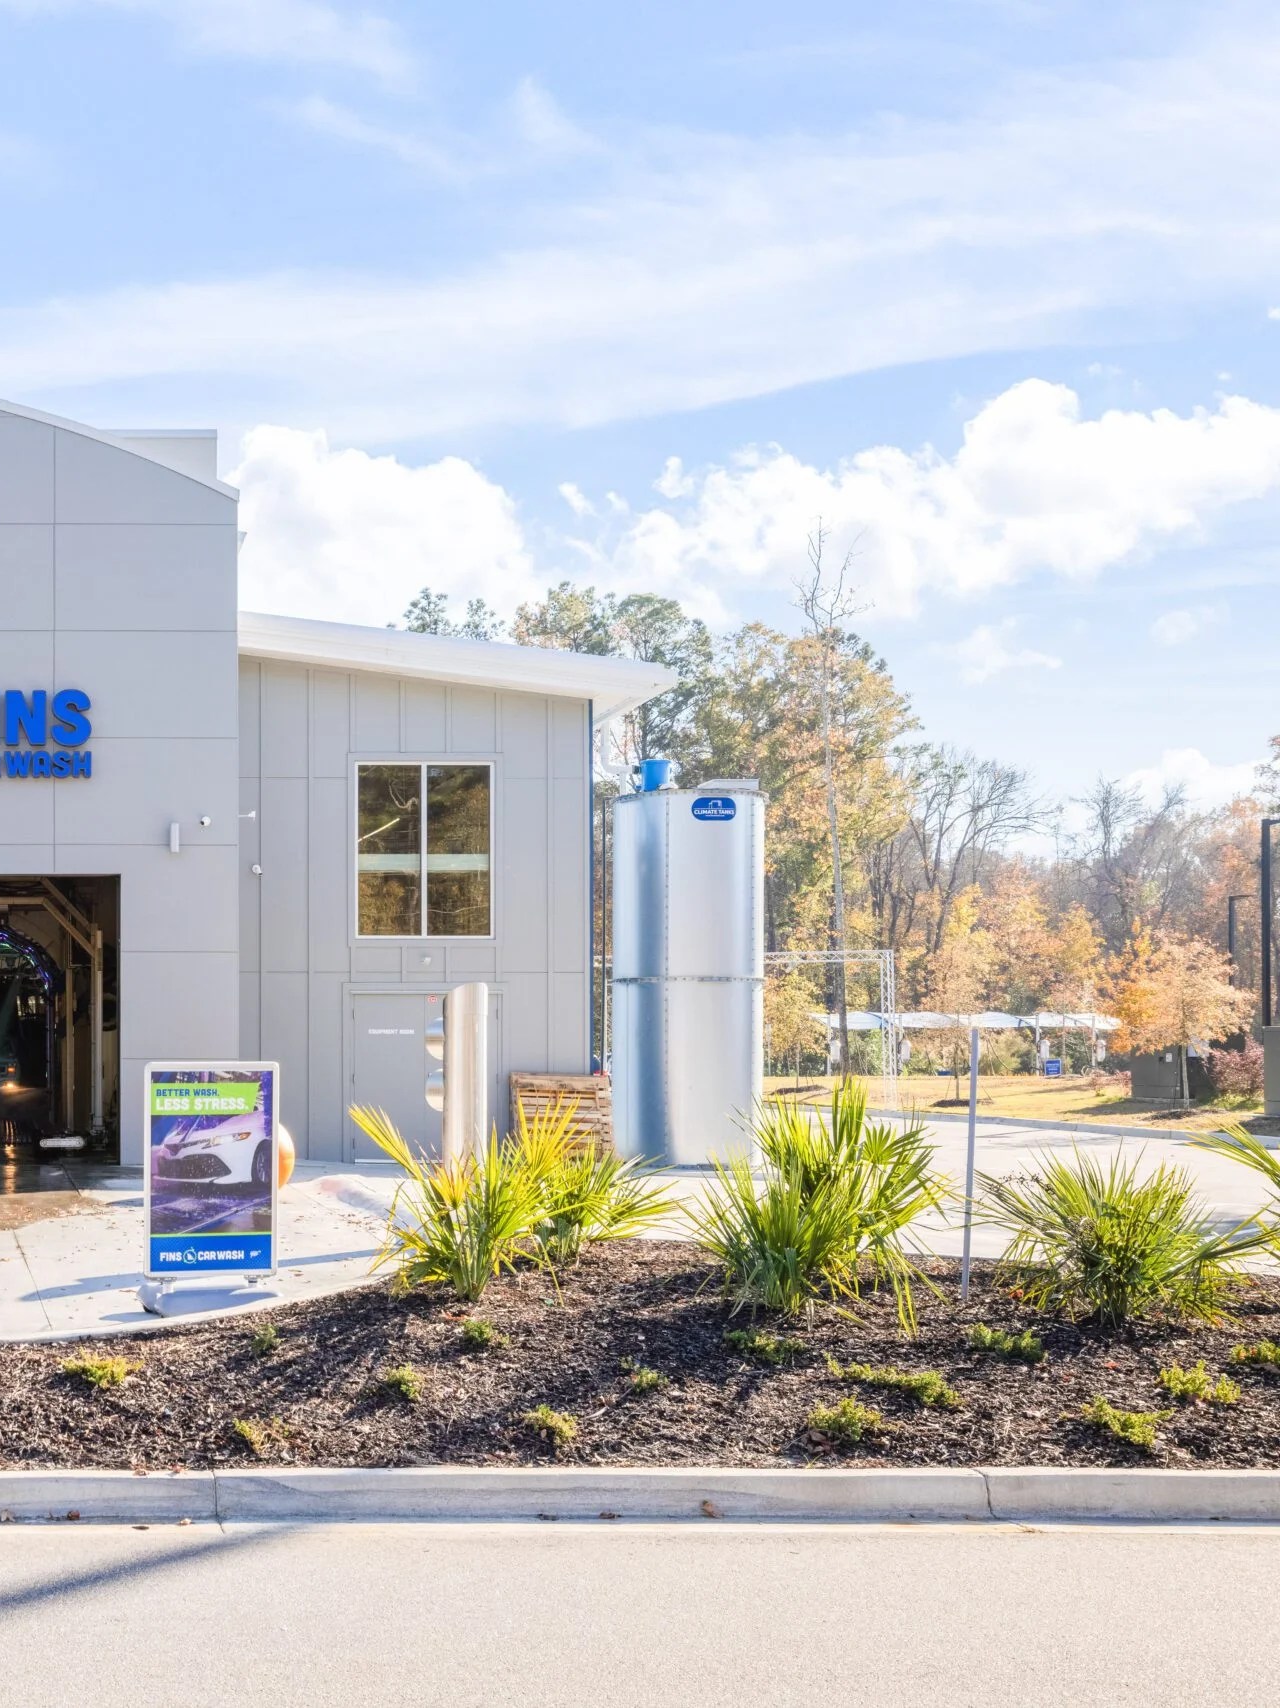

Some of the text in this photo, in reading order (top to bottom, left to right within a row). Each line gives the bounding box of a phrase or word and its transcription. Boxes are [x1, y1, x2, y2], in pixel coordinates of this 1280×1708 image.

[4, 750, 92, 779] WASH
[156, 1088, 220, 1097] BETTER WASH.
[155, 1097, 250, 1111] LESS STRESS.
[159, 1252, 182, 1262] FINS
[197, 1251, 217, 1261] CAR
[216, 1250, 245, 1261] WASH
